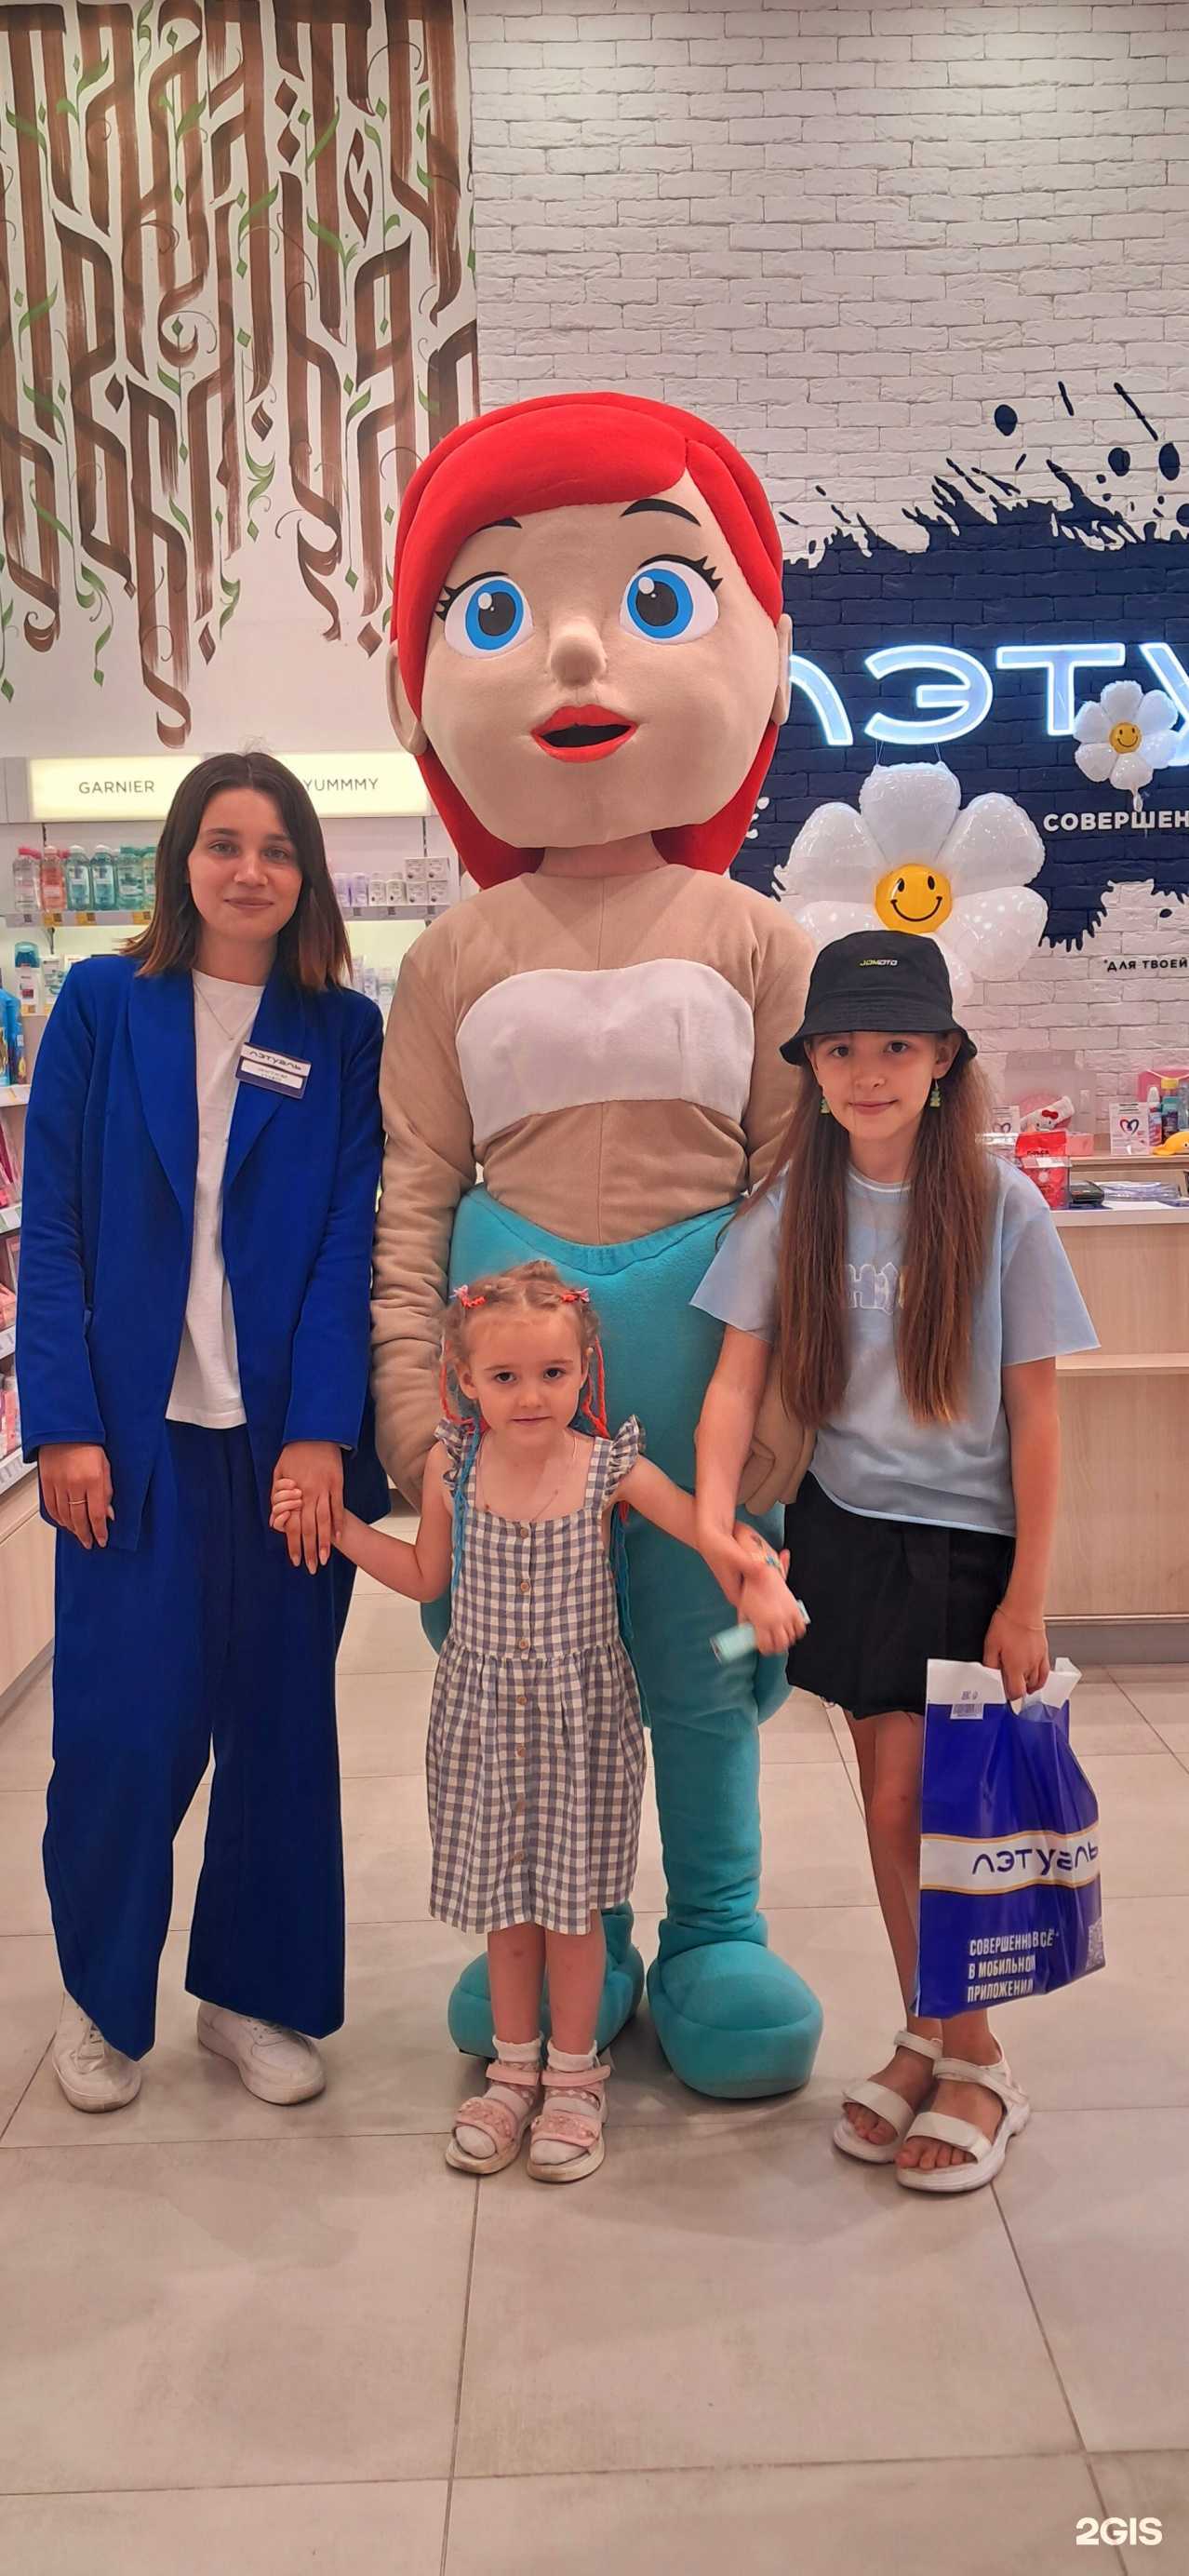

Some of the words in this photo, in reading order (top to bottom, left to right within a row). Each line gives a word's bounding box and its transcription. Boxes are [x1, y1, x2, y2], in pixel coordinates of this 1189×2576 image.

[78, 780, 155, 795] GARNIER
[1043, 811, 1189, 832] СОВЕРШЕН
[1143, 957, 1188, 970] ТВОЕЙ
[972, 1842, 1098, 1876] ЛЭТУЕЛЬ
[968, 1963, 976, 1979] В
